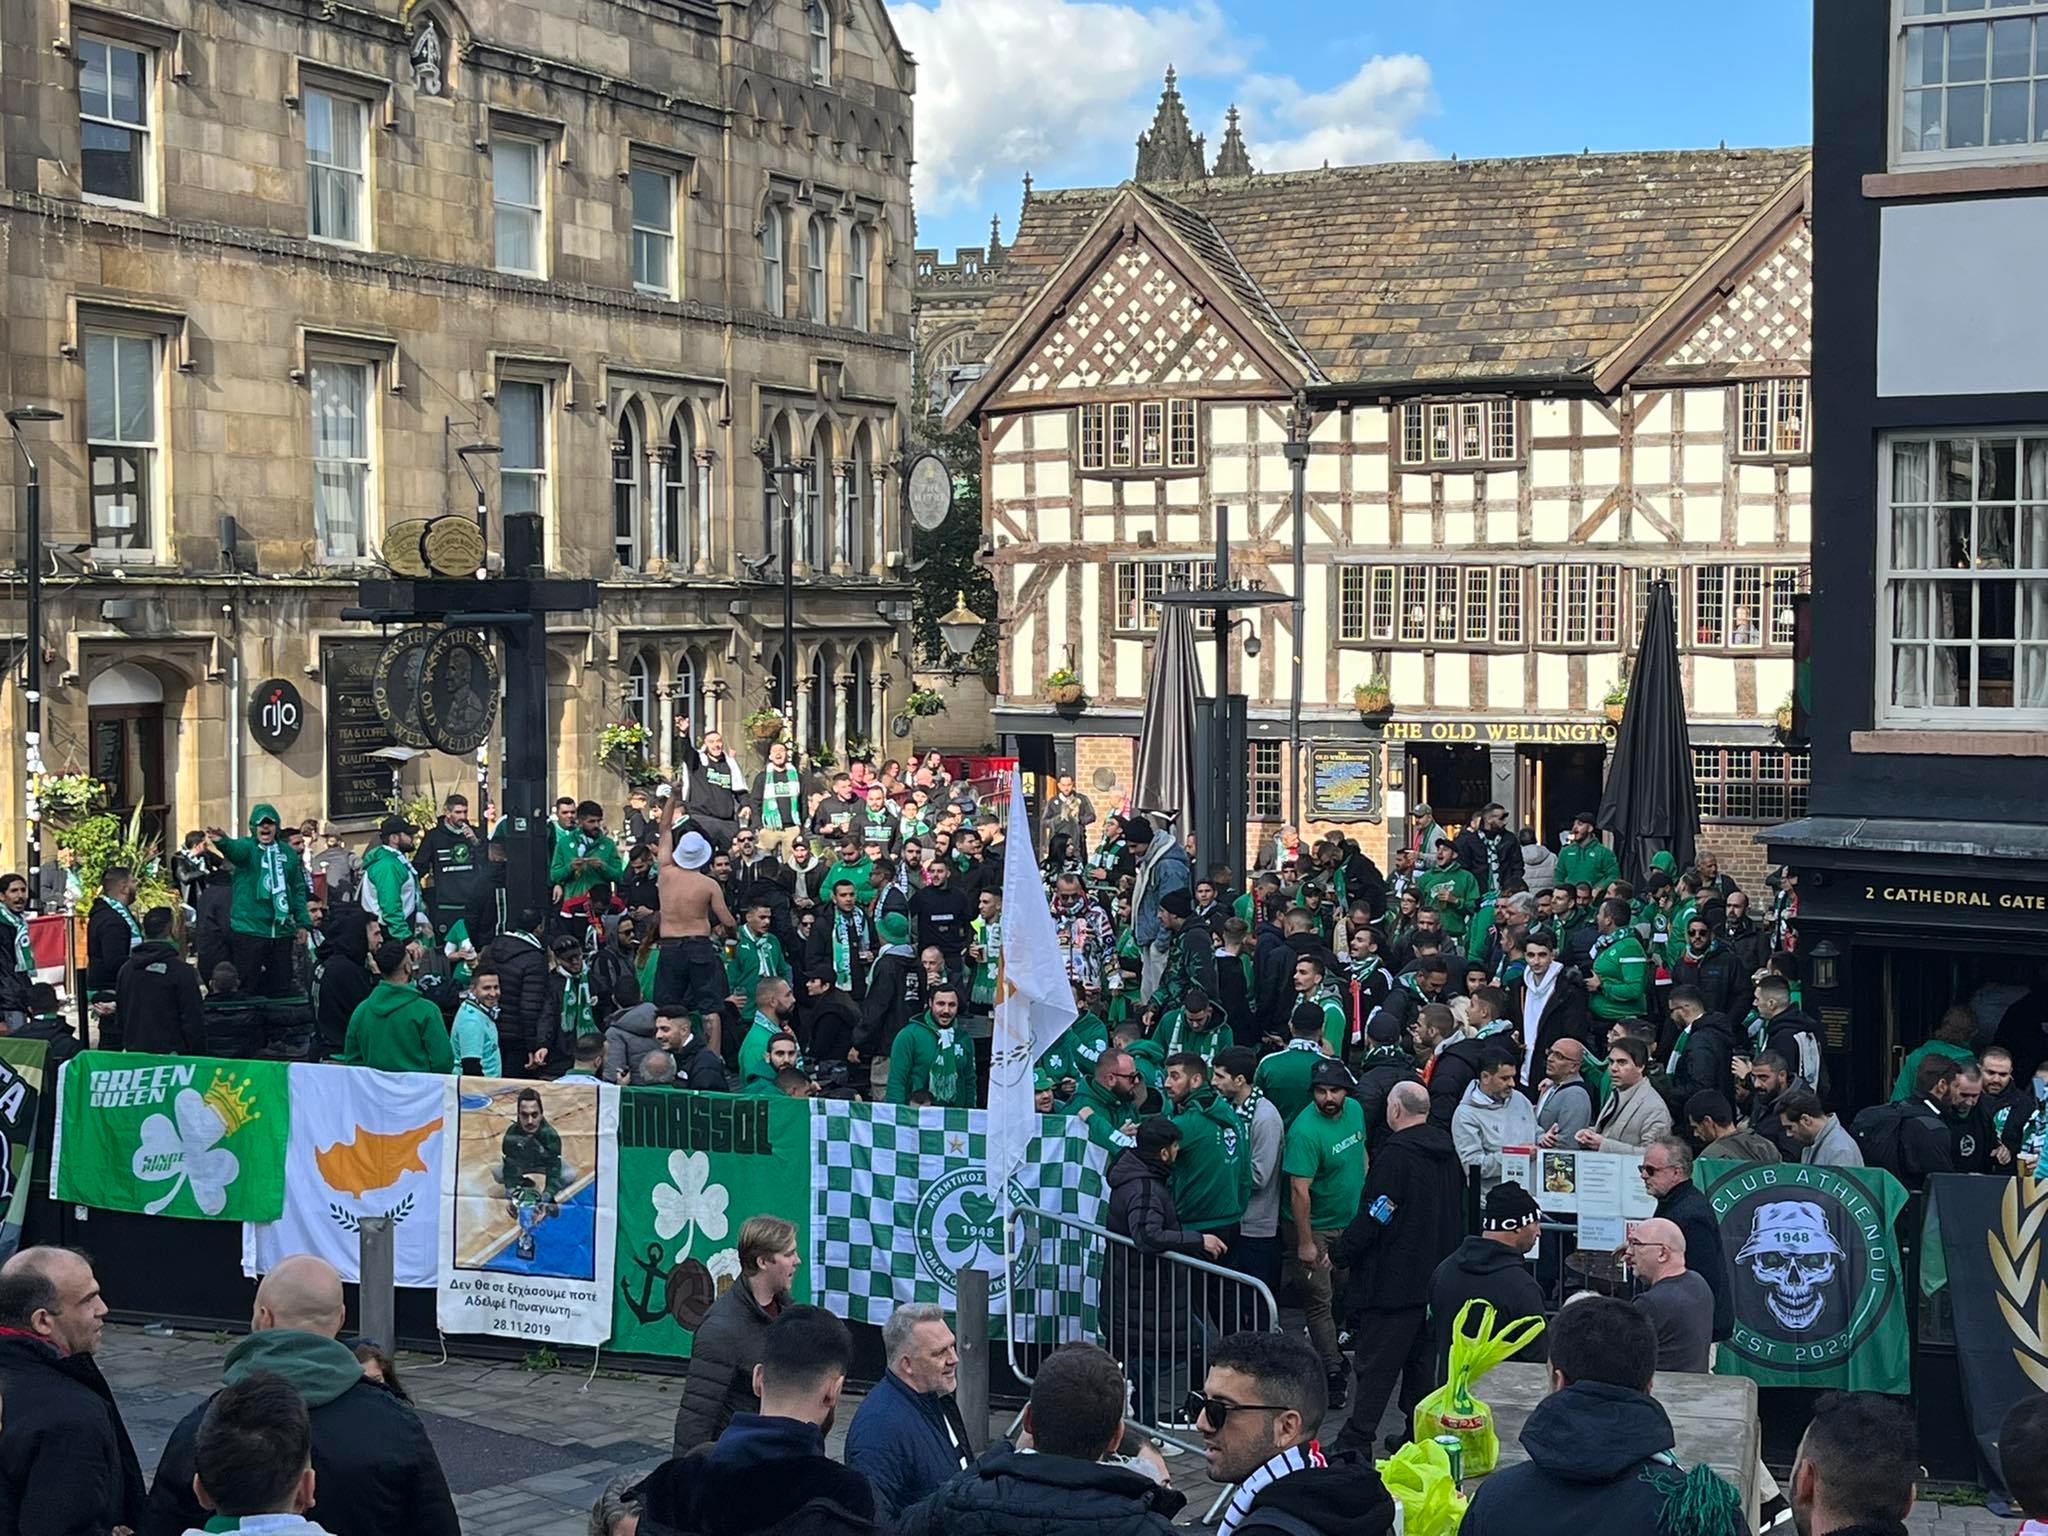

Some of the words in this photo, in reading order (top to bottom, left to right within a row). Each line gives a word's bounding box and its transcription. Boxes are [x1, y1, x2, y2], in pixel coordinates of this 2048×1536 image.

[447, 631, 474, 645] THE
[375, 687, 391, 720] OLD
[262, 697, 297, 736] rijo
[421, 691, 437, 726] OLD
[437, 689, 499, 750] WELLINGTON
[339, 728, 353, 738] TEA
[354, 727, 361, 738] &
[1382, 723, 1423, 739] THE
[1431, 723, 1477, 740] OLD
[1486, 723, 1618, 742] WELLINGTO
[1865, 887, 1875, 899] 2
[1883, 887, 1991, 907] CATHEDRAL
[90, 1063, 197, 1092] GREEN
[90, 1088, 166, 1108] QUEEN
[143, 1152, 188, 1164] SINCE
[926, 1172, 984, 1209] ΑΘΛΗΤΙΚΟΣ
[961, 1225, 995, 1238] 1948
[1711, 1169, 1778, 1215] CLUB
[1795, 1169, 1887, 1283] ATHIENOU
[1773, 1231, 1810, 1244] 1948
[924, 1250, 957, 1286] ΟΜΟΝΟ
[449, 1278, 472, 1290] Δεν
[492, 1283, 504, 1293] σε
[507, 1282, 567, 1301] ξεχάσουμε
[464, 1295, 507, 1311] Αδελφέ
[493, 1318, 551, 1336] 28.11.2019
[1734, 1329, 1776, 1357] EST
